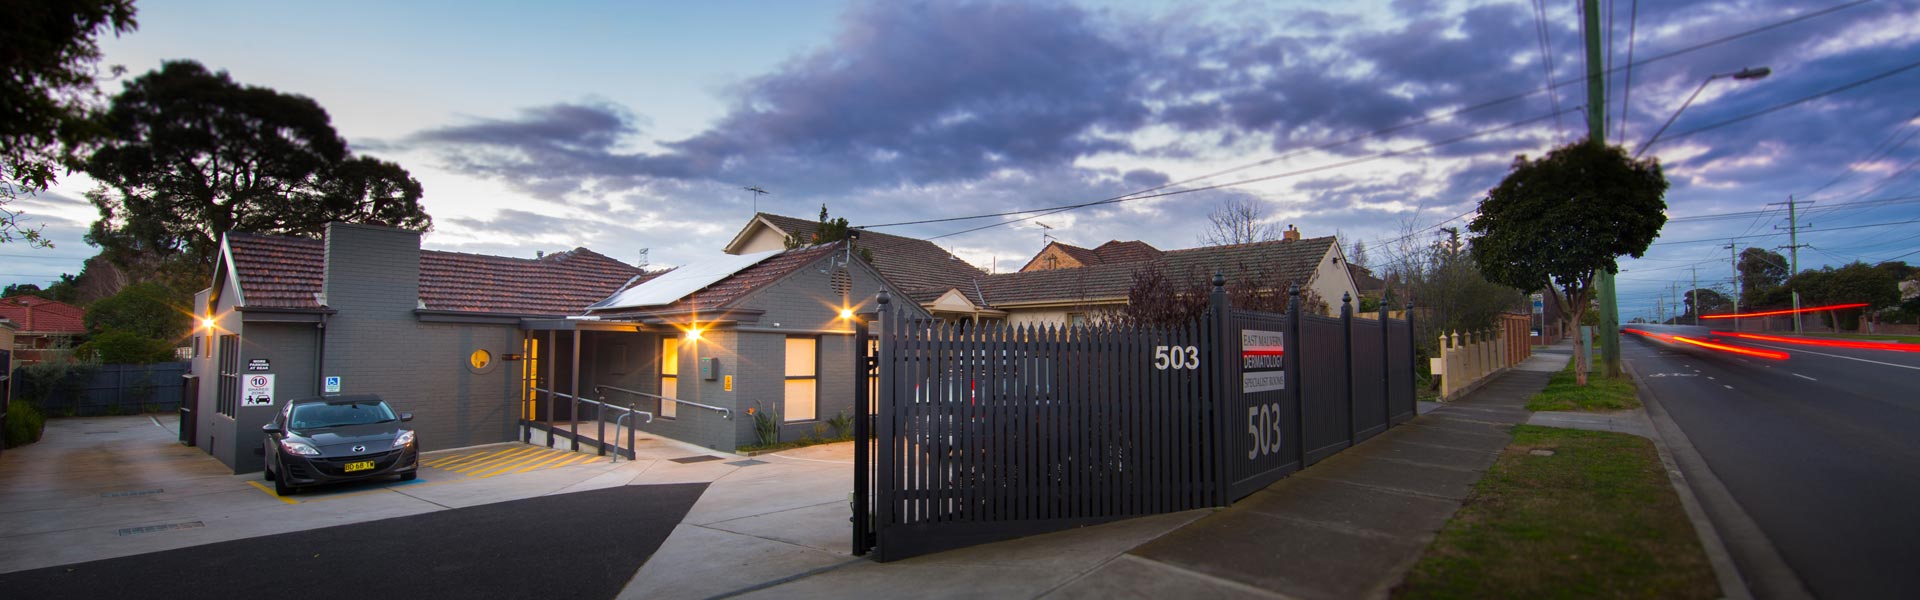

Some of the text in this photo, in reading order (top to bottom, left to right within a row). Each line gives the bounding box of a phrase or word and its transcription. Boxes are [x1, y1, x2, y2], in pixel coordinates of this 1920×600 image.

[1243, 335, 1258, 346] EAST
[1154, 345, 1200, 370] 503
[1243, 355, 1283, 369] DERMATOLOGY
[253, 378, 265, 386] 10
[1248, 402, 1281, 460] 503
